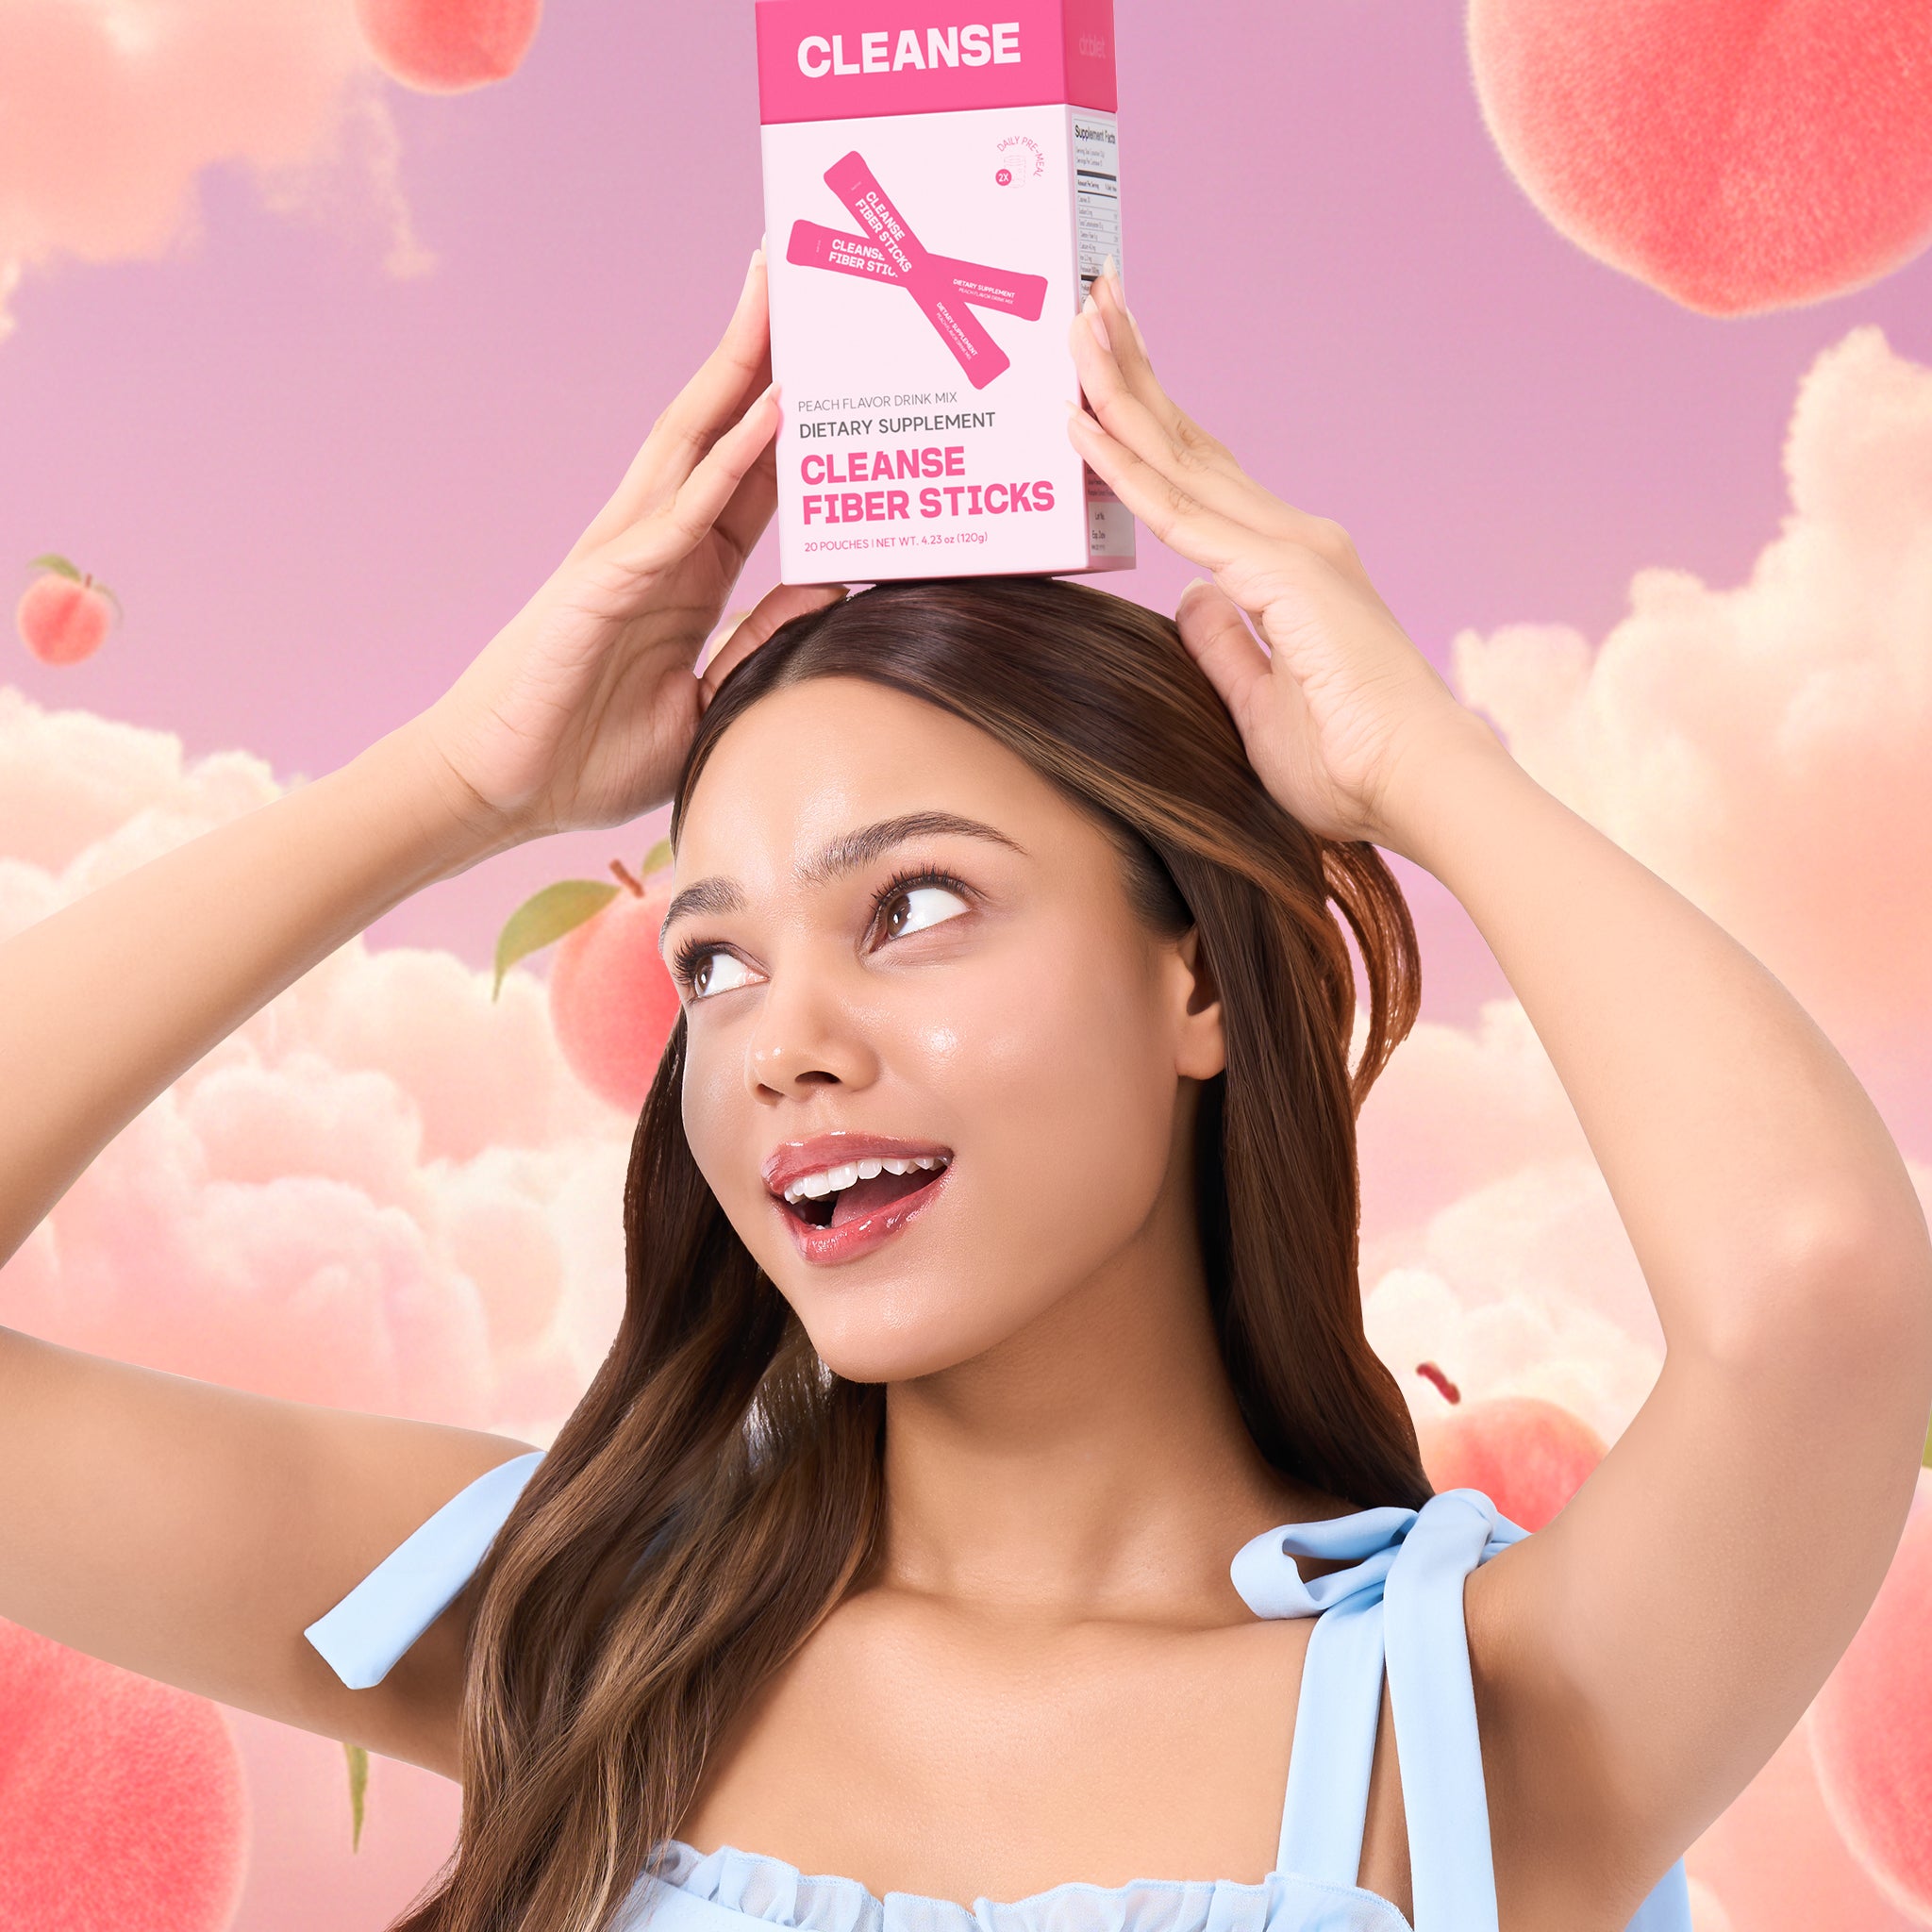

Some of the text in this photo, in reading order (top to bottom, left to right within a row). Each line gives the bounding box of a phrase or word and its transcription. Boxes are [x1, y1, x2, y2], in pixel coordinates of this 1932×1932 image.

[797, 22, 1022, 78] CLEANSE
[1075, 125, 1104, 142] Supplement
[997, 136, 1020, 152] DAILY
[1022, 137, 1044, 177] PRE-MEAL
[998, 173, 1009, 182] 2X
[866, 192, 906, 242] CLEANSE
[855, 198, 912, 273] FIBER STICKS
[828, 251, 865, 270] FIBER
[953, 278, 1016, 298] DIETARY SUPPLEMENT
[936, 302, 978, 356] DIETARY SUPPLEMENT
[798, 391, 958, 412] PEACH FLAVOR DRINK MIX
[799, 411, 996, 439] DIETARY SUPPLEMENT
[800, 445, 966, 486] CLEANSE
[802, 480, 1056, 525] FIBER STICKS
[805, 542, 818, 552] 20
[820, 539, 869, 551] POUCHES
[876, 538, 895, 548] NET
[899, 536, 919, 547] WT.
[922, 534, 941, 545] 4.23
[944, 536, 955, 544] oz
[957, 532, 988, 544] (120g)
